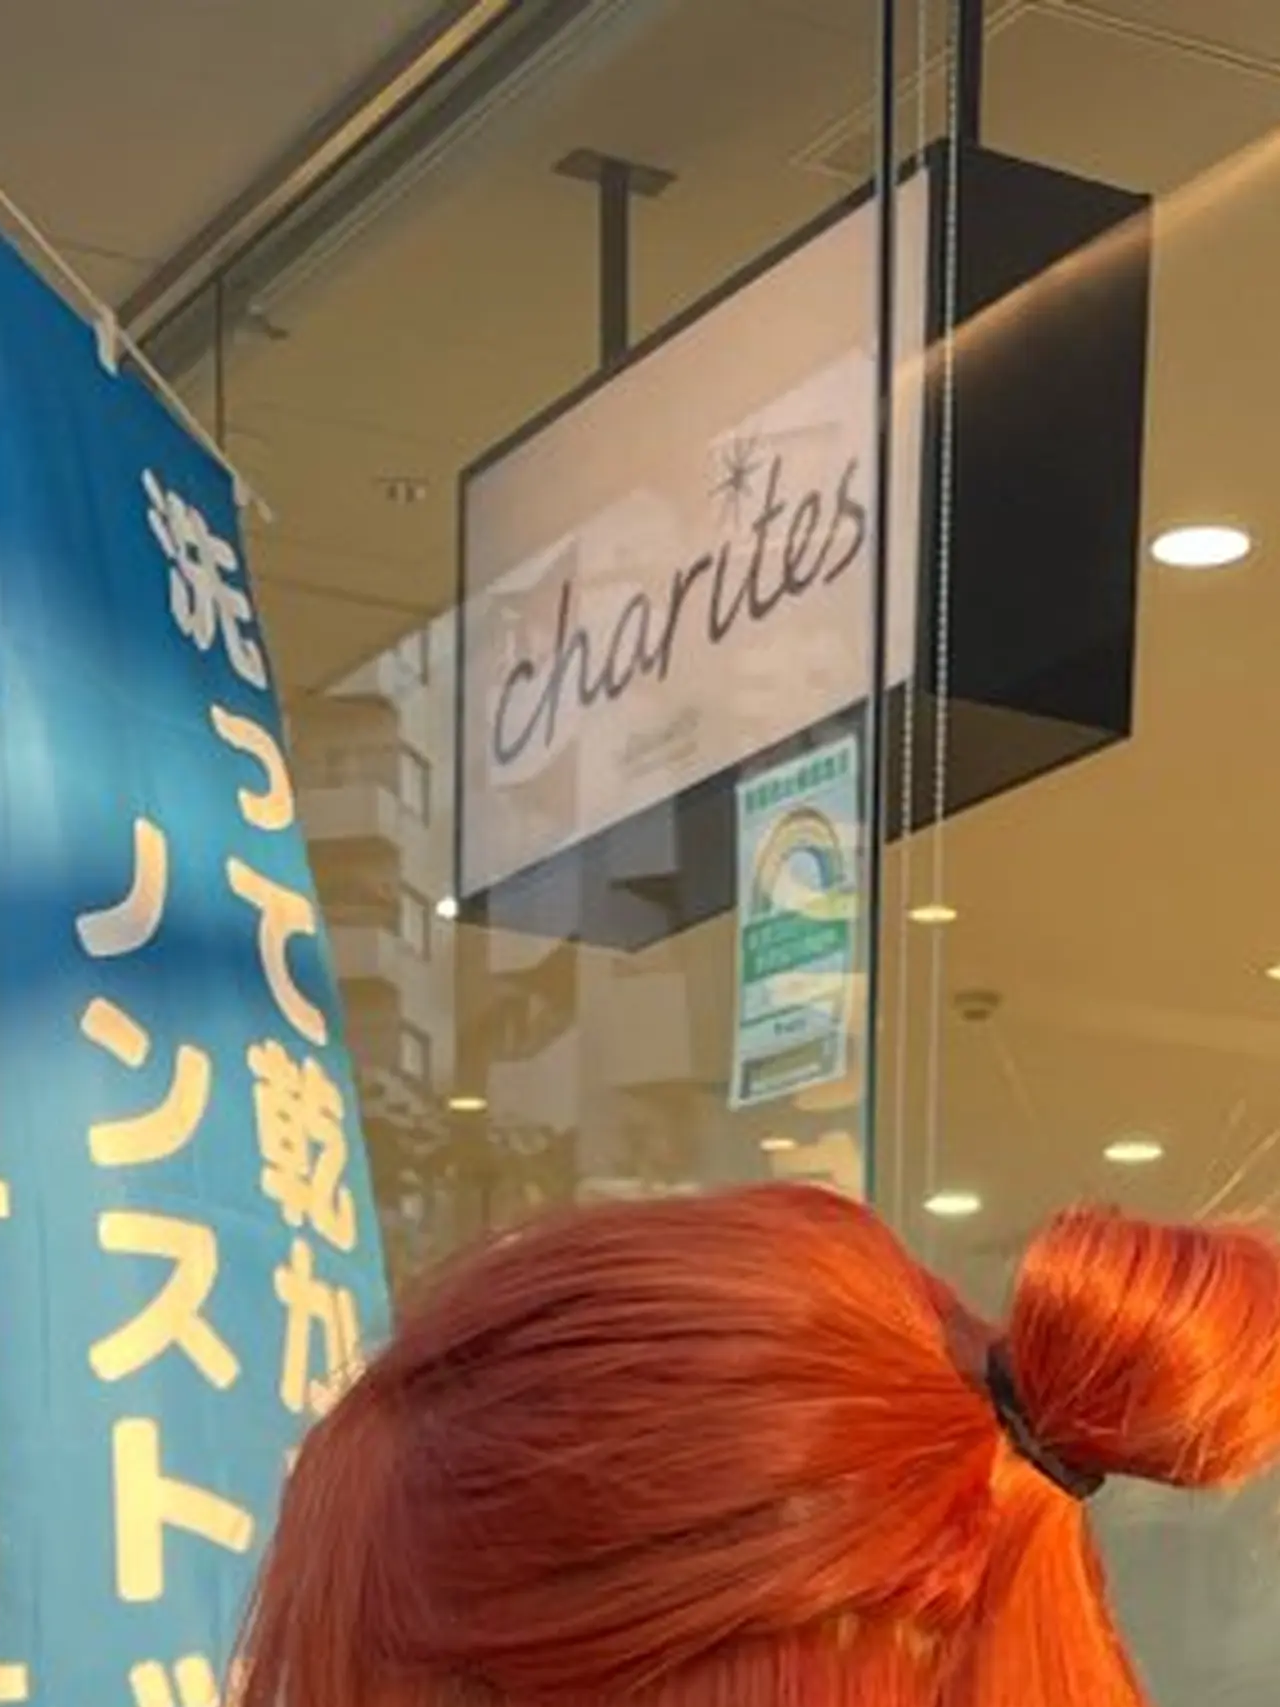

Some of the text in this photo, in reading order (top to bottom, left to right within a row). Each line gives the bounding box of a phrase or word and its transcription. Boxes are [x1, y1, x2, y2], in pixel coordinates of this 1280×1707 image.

[492, 436, 867, 767] charites
[142, 467, 368, 1476] 洗って乾か
